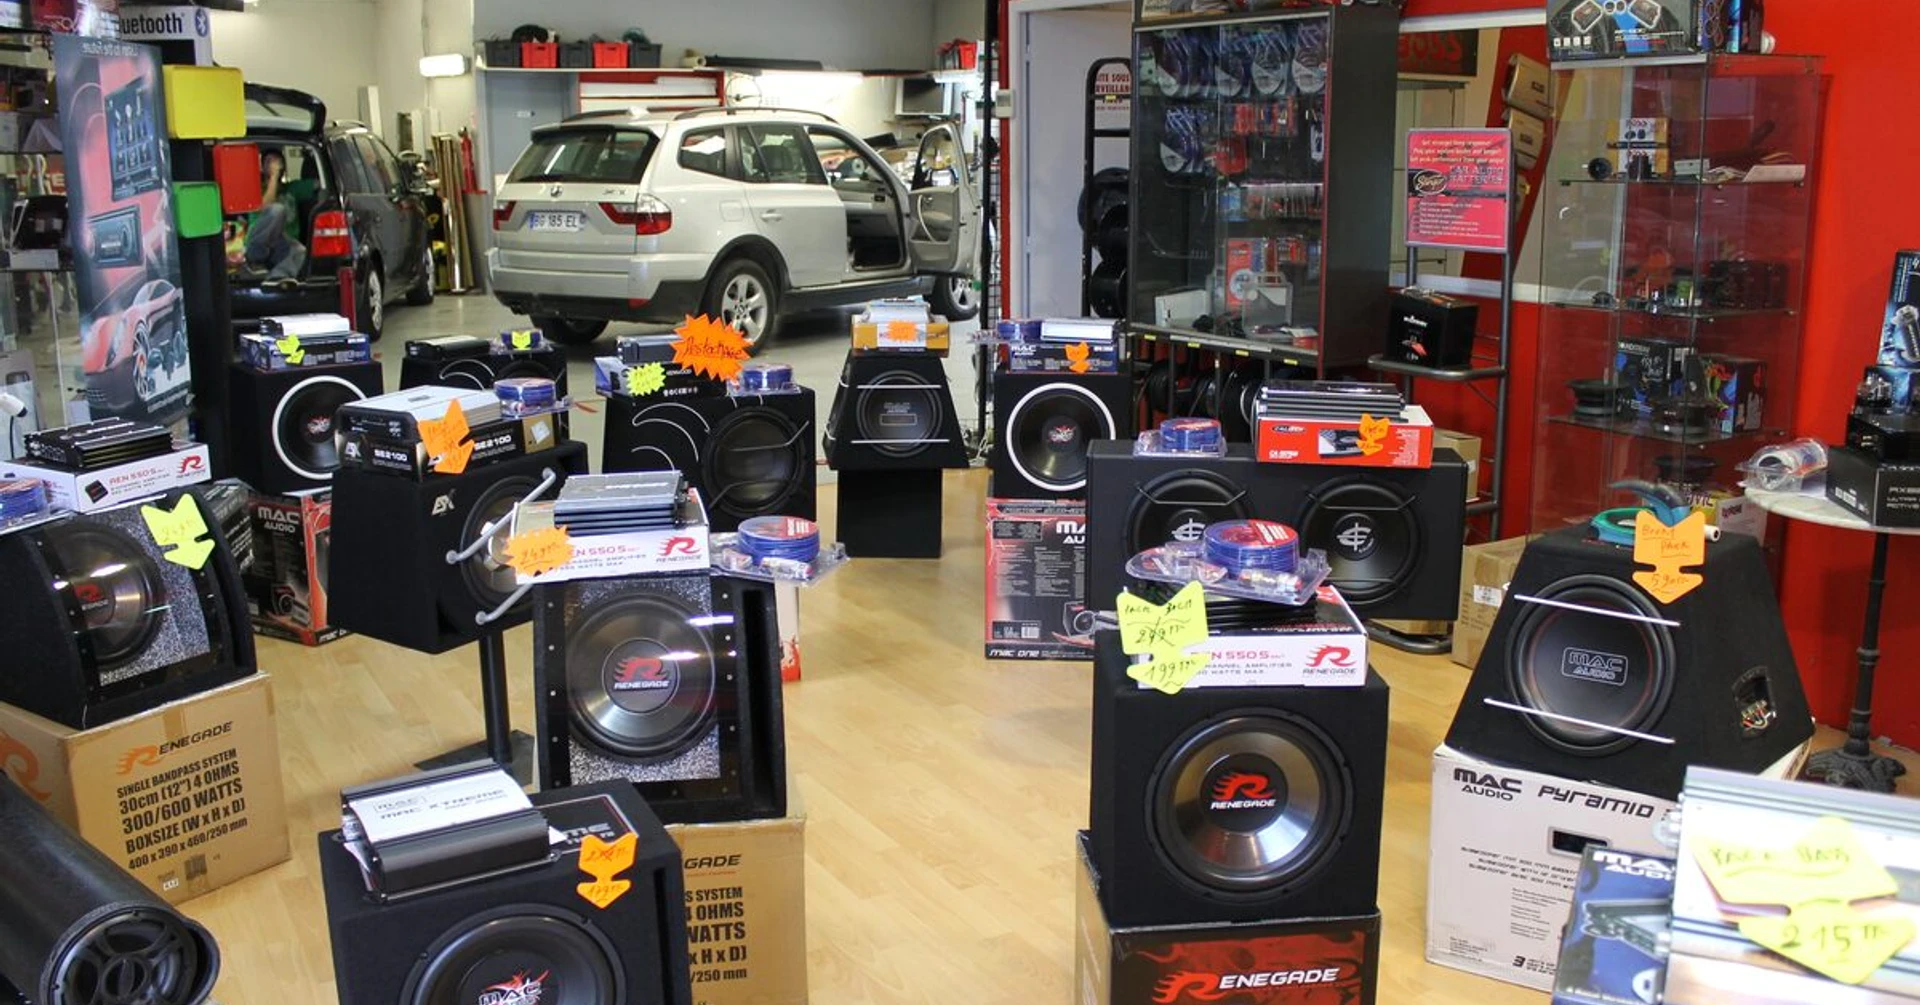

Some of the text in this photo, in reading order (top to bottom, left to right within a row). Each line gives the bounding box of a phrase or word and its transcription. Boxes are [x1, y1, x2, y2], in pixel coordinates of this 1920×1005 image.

[257, 504, 300, 525] MAC
[263, 521, 297, 534] AUDIO
[1568, 650, 1624, 674] MAC
[1303, 667, 1357, 675] RENEGADE
[1572, 665, 1617, 681] AUDIO
[614, 680, 671, 690] RENEGADE
[116, 748, 238, 799] SINGLE BANDPASS SYSTEM
[1453, 767, 1523, 794] MAC
[118, 794, 160, 815] 30cm
[193, 773, 202, 788] 4
[204, 760, 240, 784] OHMS
[1461, 784, 1514, 801] AUDIO
[121, 777, 243, 835] 300/600 WATTS
[1210, 797, 1277, 810] RENEGADE
[125, 822, 181, 855] BOXSIZE
[211, 807, 222, 822] H
[128, 853, 149, 870] 400
[158, 842, 179, 859] 390
[684, 853, 742, 870] GADE
[695, 886, 743, 902] SYSTEM
[696, 901, 744, 921] OHMS
[701, 948, 713, 965] H
[716, 949, 726, 963] x
[723, 968, 747, 980] mm
